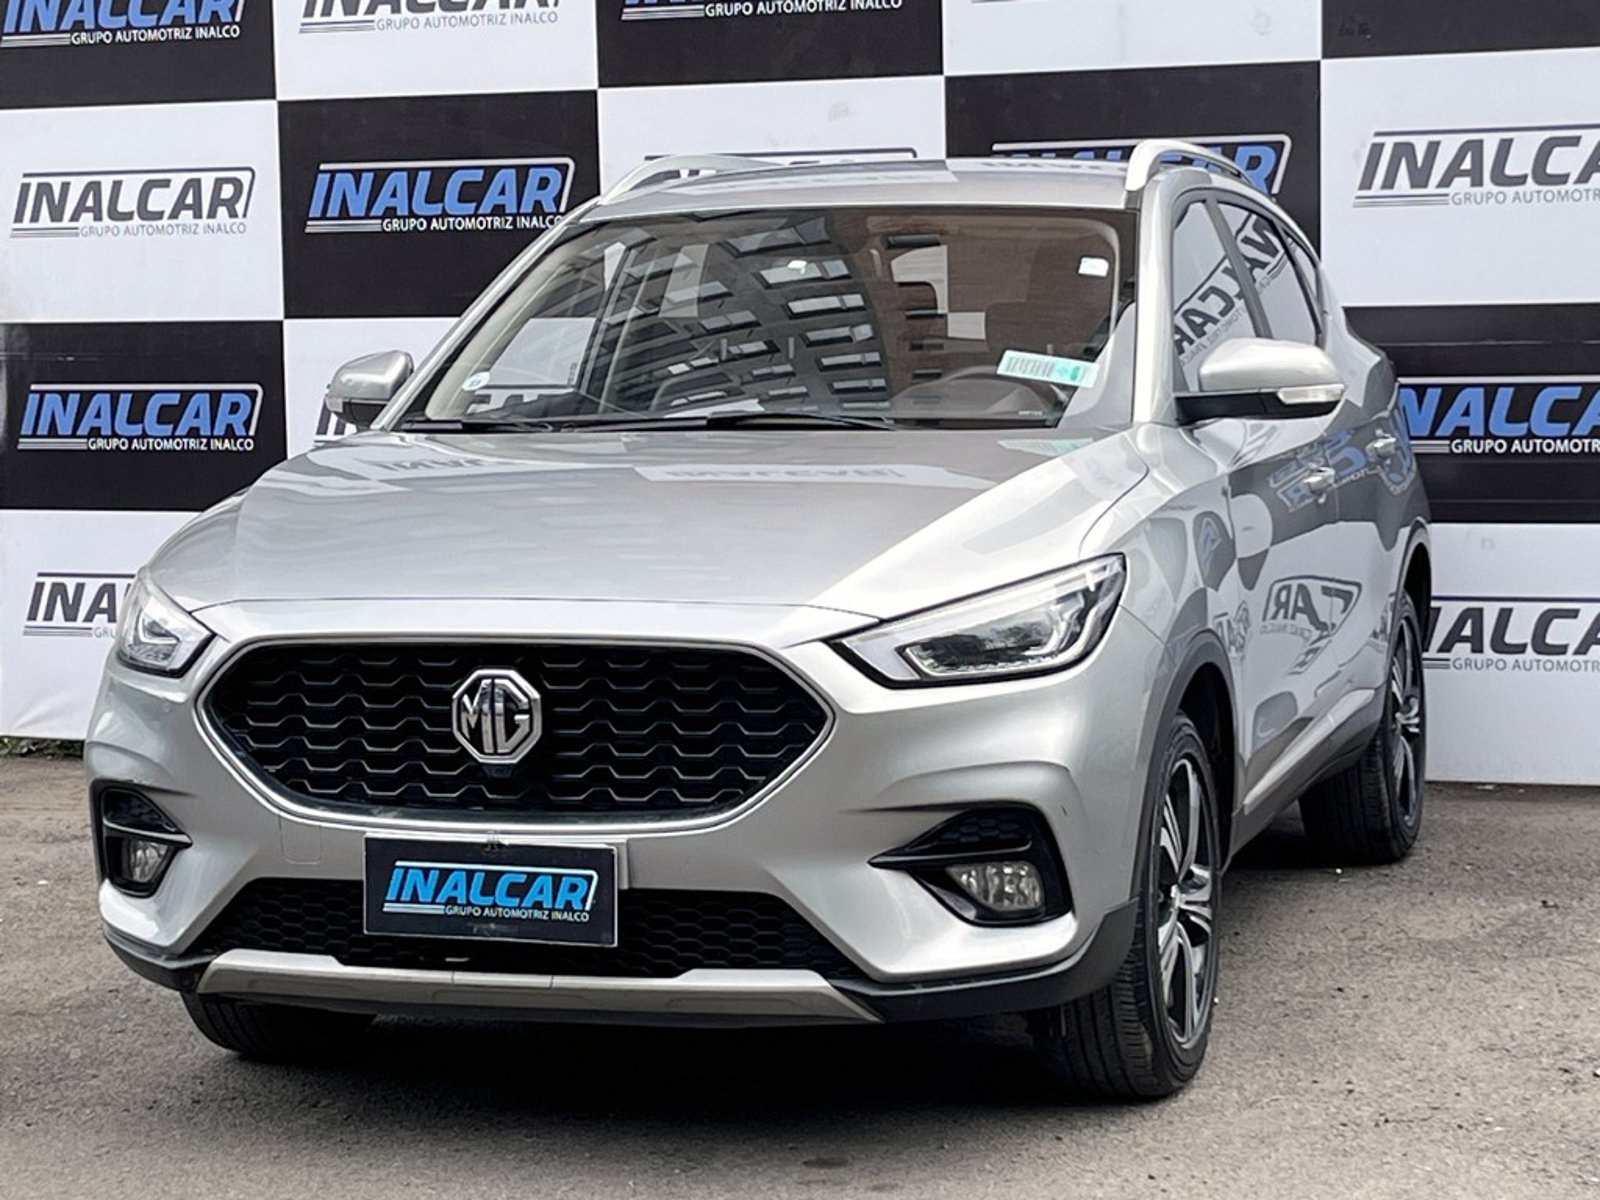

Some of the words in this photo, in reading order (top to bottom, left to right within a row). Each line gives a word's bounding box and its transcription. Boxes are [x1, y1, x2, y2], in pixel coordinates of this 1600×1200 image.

[705, 2, 752, 17] GRUPO
[756, 0, 847, 15] AUTOMOTRIZ
[850, 0, 902, 10] INALCO
[376, 17, 421, 31] GRUPO
[423, 13, 507, 30] AUTOMOTRIZ
[510, 10, 559, 25] INALCO
[71, 31, 113, 45] GRUPO
[115, 26, 193, 43] AUTOMOTRIZ
[195, 24, 240, 40] INALCO
[13, 177, 245, 224] INALCAR
[308, 166, 563, 218] INALCAR
[1450, 191, 1508, 206] GRUPO
[1511, 187, 1600, 204] AUTOMOTR
[79, 225, 121, 238] GRUPO
[122, 223, 200, 237] AUTOMOTRIZ
[202, 221, 248, 235] INALCO
[382, 218, 428, 232] GRUPO
[429, 217, 514, 231] AUTOMOTRIZ
[20, 392, 252, 436] INALCAR
[88, 437, 129, 451] GRUPO
[131, 437, 208, 451] AUTOMOTRIZ
[210, 437, 255, 451] INALCO
[1450, 438, 1508, 454] GRUPO
[1511, 438, 1600, 454] AUTOMOTR
[27, 581, 131, 623] INA
[1451, 657, 1508, 671] GRUPO
[1511, 658, 1600, 673] AUTOMOTR
[459, 678, 531, 754] MG
[385, 868, 589, 910] INALCAR
[445, 905, 482, 917] GRUPO
[483, 908, 550, 921] AUTOMOTRIZ
[551, 910, 590, 923] INALCO
